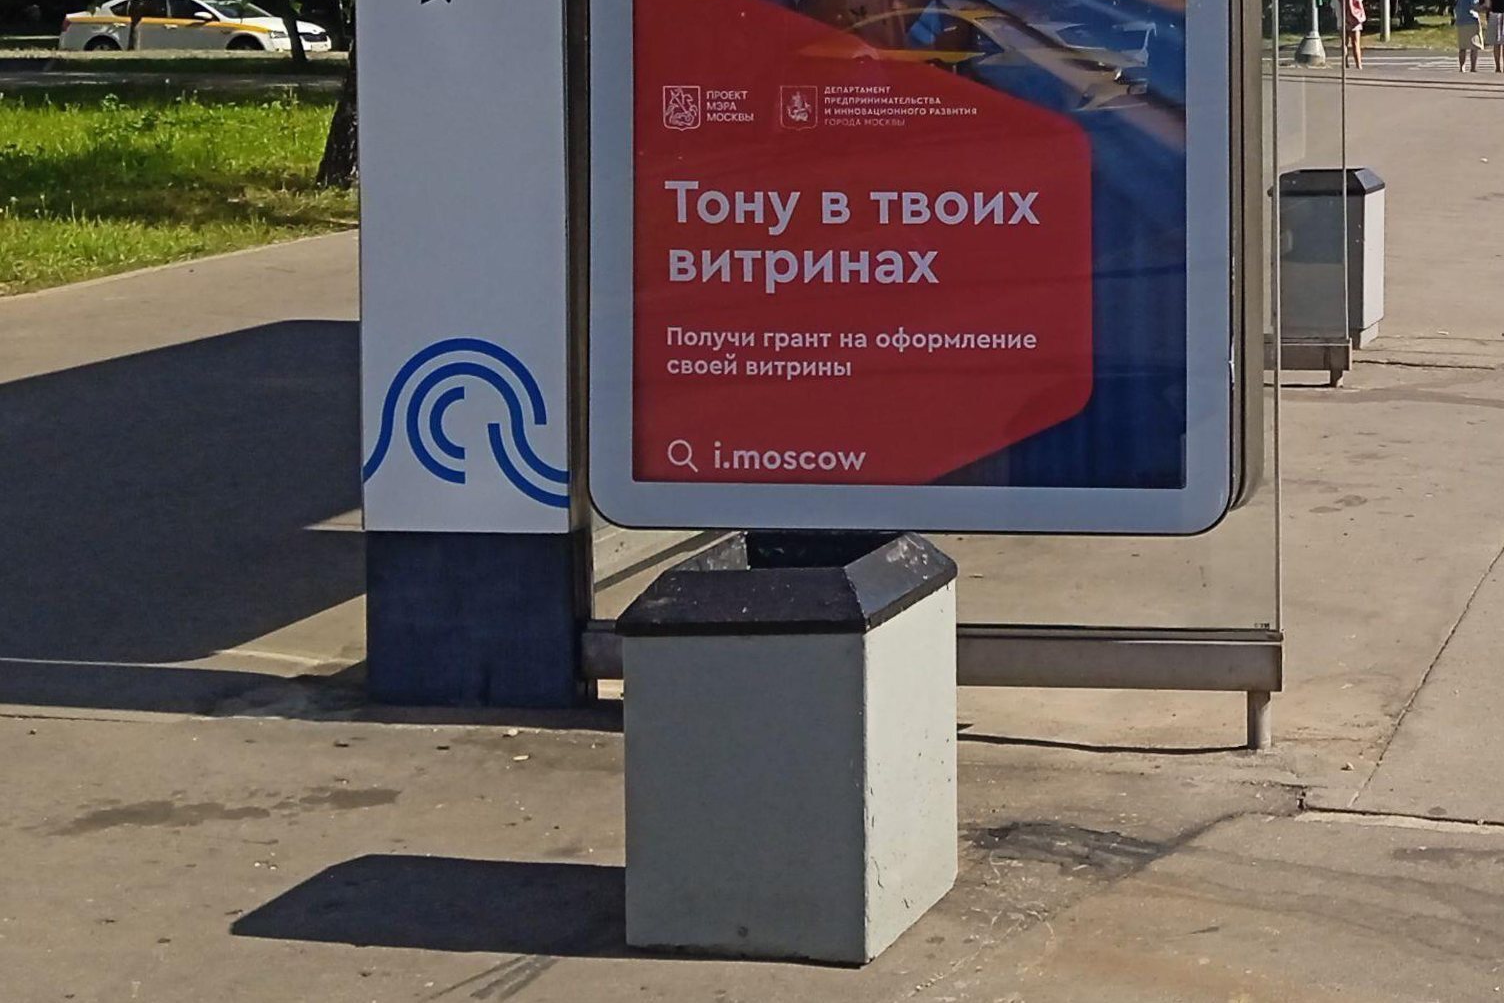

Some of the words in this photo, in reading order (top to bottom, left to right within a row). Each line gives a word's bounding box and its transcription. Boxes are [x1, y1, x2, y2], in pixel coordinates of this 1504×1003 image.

[706, 90, 749, 100] ПРОЕКТ
[824, 86, 891, 95] ДЕПАРТАМЕНТ
[706, 101, 738, 111] МЭРА
[824, 96, 942, 106] ПРЕДПРИНИМАТЕЛЬСТВА
[824, 107, 832, 116] И
[834, 107, 927, 116] ИННОВАЦИОННОГО
[929, 107, 978, 116] РАЗВИТИЯ
[706, 112, 754, 122] МОСКВЫ
[664, 180, 801, 236] Тону
[821, 191, 851, 225] в
[869, 190, 1041, 227] твоих
[668, 248, 940, 294] витринах
[666, 326, 756, 354] Получи
[763, 332, 832, 354] грант
[839, 333, 868, 349] на
[875, 326, 1038, 354] оформление
[666, 353, 737, 376] своей
[746, 360, 852, 381] витрины
[713, 440, 867, 472] i.moscow
